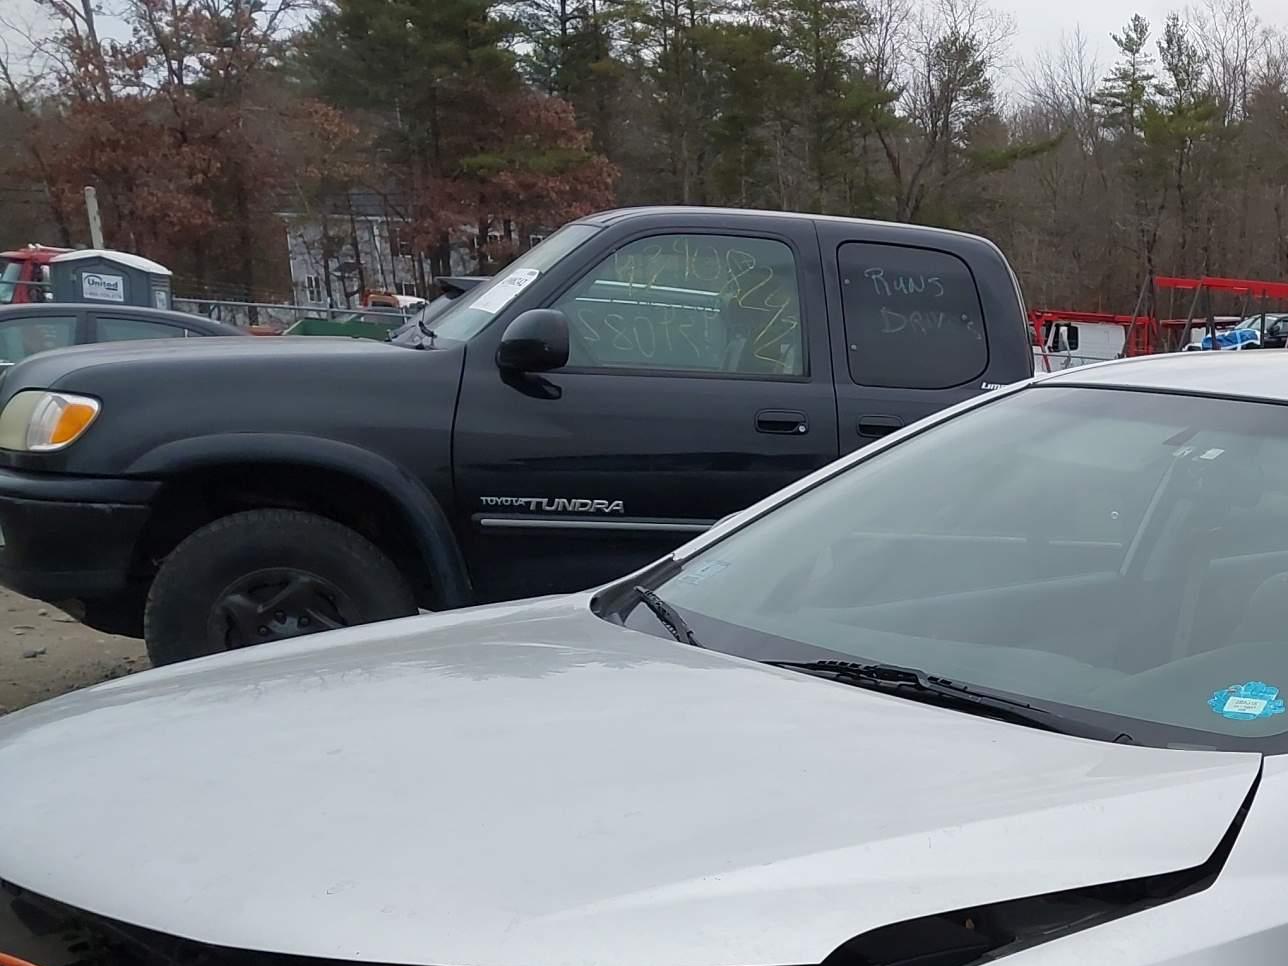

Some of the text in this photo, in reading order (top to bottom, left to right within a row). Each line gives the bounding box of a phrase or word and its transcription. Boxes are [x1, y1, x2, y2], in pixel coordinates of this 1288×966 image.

[87, 279, 118, 289] United
[480, 496, 625, 513] TOYOTA TUNDRA
